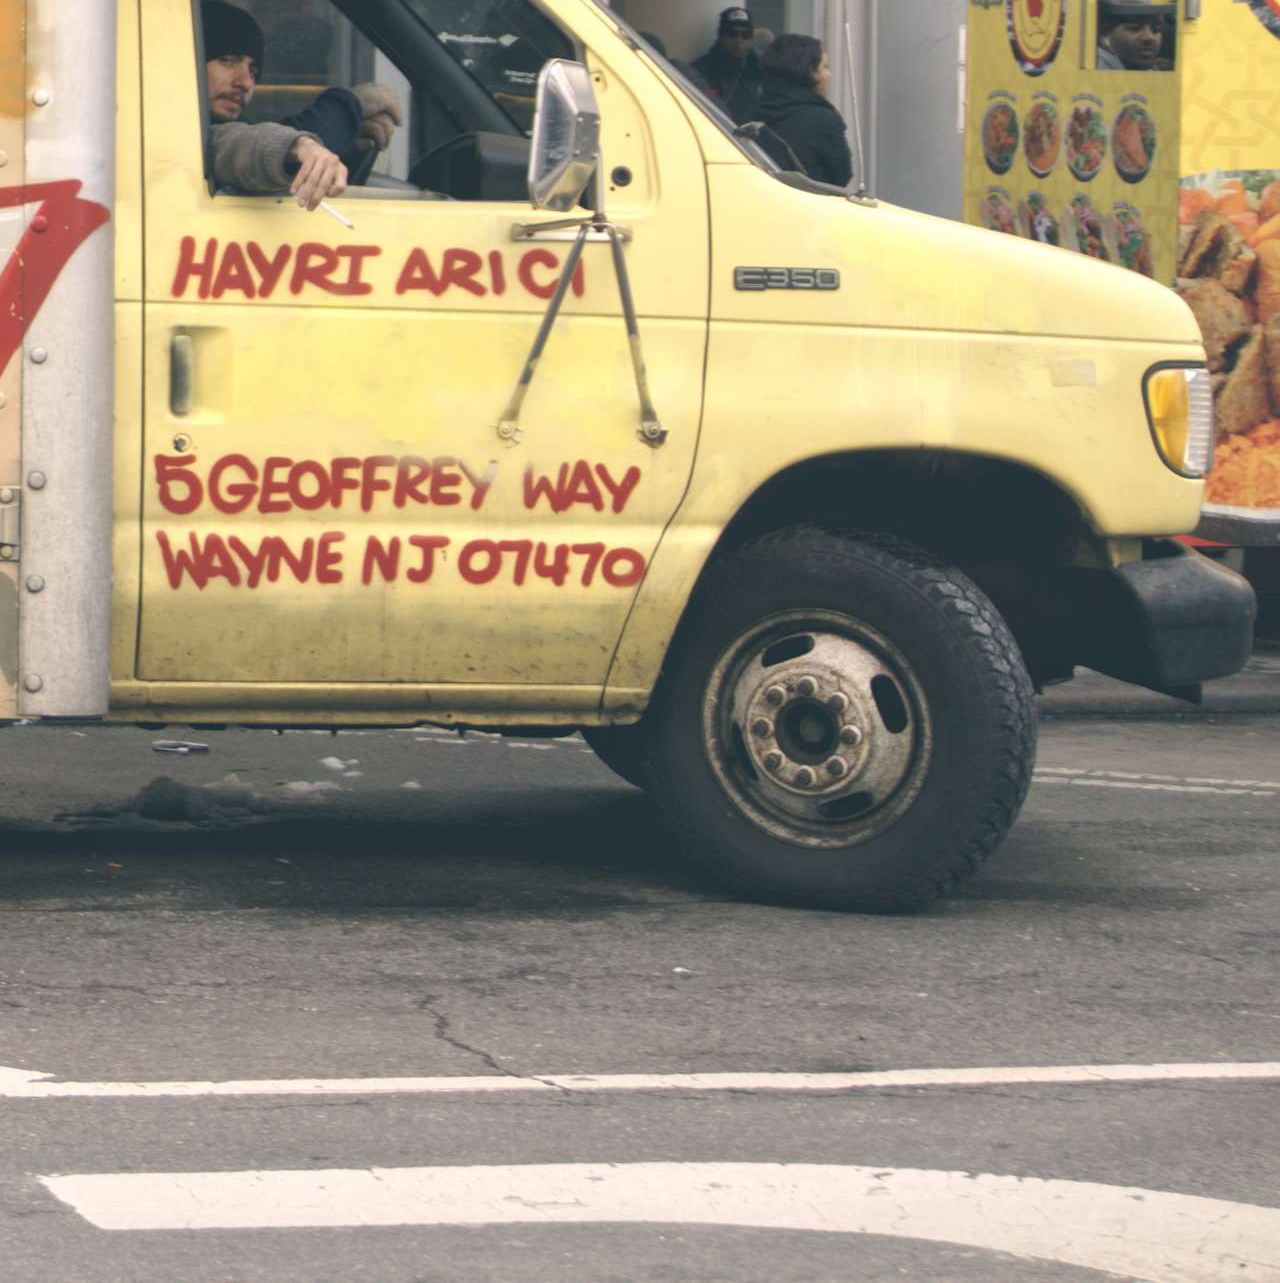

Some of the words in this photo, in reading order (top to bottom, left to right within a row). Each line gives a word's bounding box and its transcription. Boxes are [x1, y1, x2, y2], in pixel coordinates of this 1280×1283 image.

[171, 236, 382, 299] HAYRI
[736, 267, 839, 289] E350
[154, 454, 203, 516] 5
[208, 455, 498, 514] GEOFFREY
[524, 460, 640, 514] WAY
[156, 530, 344, 591] WAYNE
[362, 534, 450, 587] NJ
[458, 541, 647, 589] 07470
